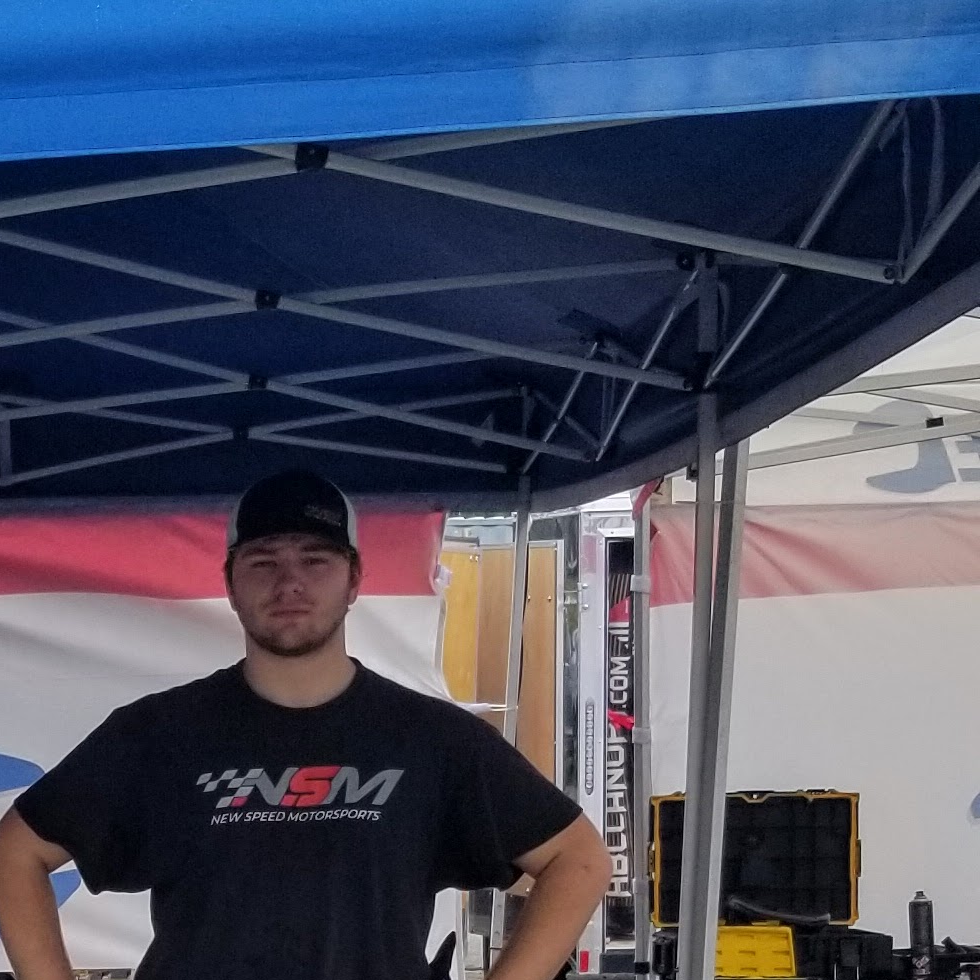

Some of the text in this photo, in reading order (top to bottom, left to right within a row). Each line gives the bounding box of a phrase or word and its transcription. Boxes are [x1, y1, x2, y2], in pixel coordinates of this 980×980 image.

[242, 765, 405, 808] NSM
[210, 809, 382, 825] NEW SPEED MOTORSPORTS
